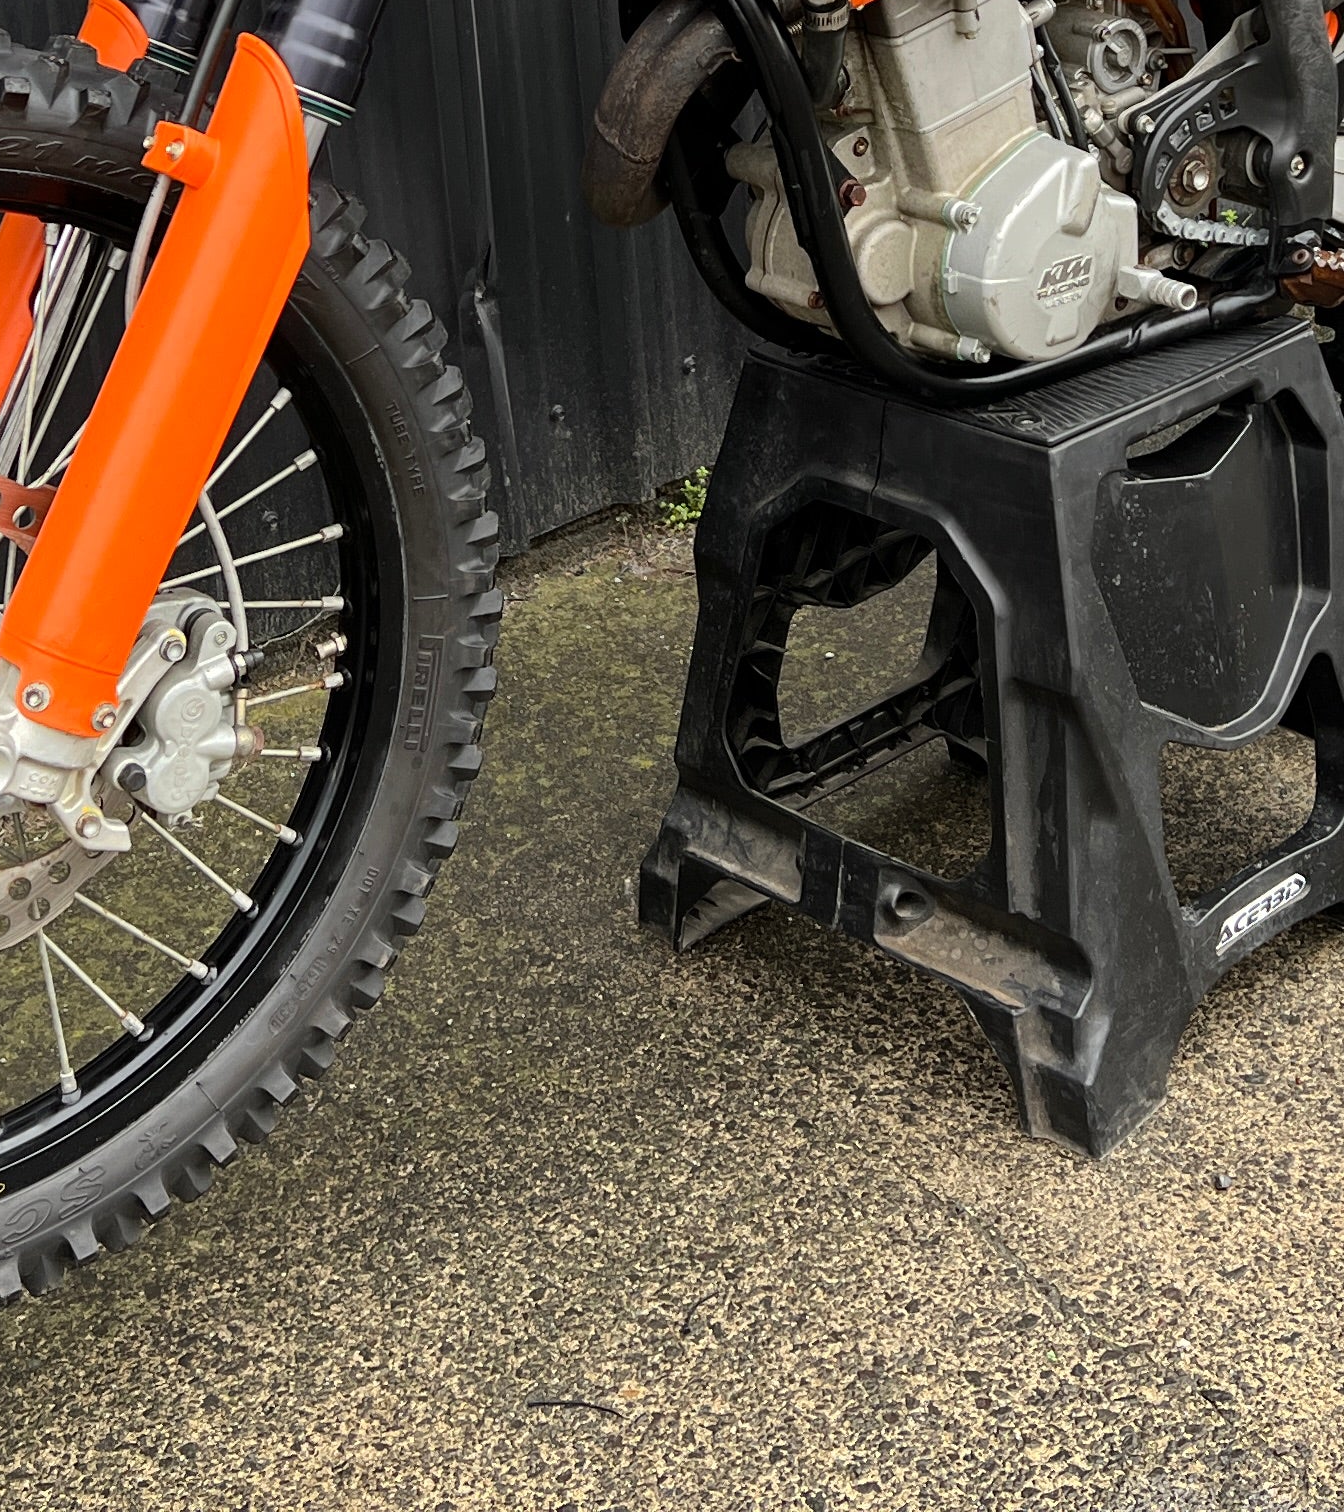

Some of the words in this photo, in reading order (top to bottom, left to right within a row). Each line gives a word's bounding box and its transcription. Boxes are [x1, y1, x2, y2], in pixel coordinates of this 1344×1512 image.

[1039, 254, 1092, 289] KTM
[385, 399, 411, 446] TUBE
[404, 446, 425, 497] TYPE
[403, 634, 446, 753] PIRELLI
[359, 866, 380, 896] DOT
